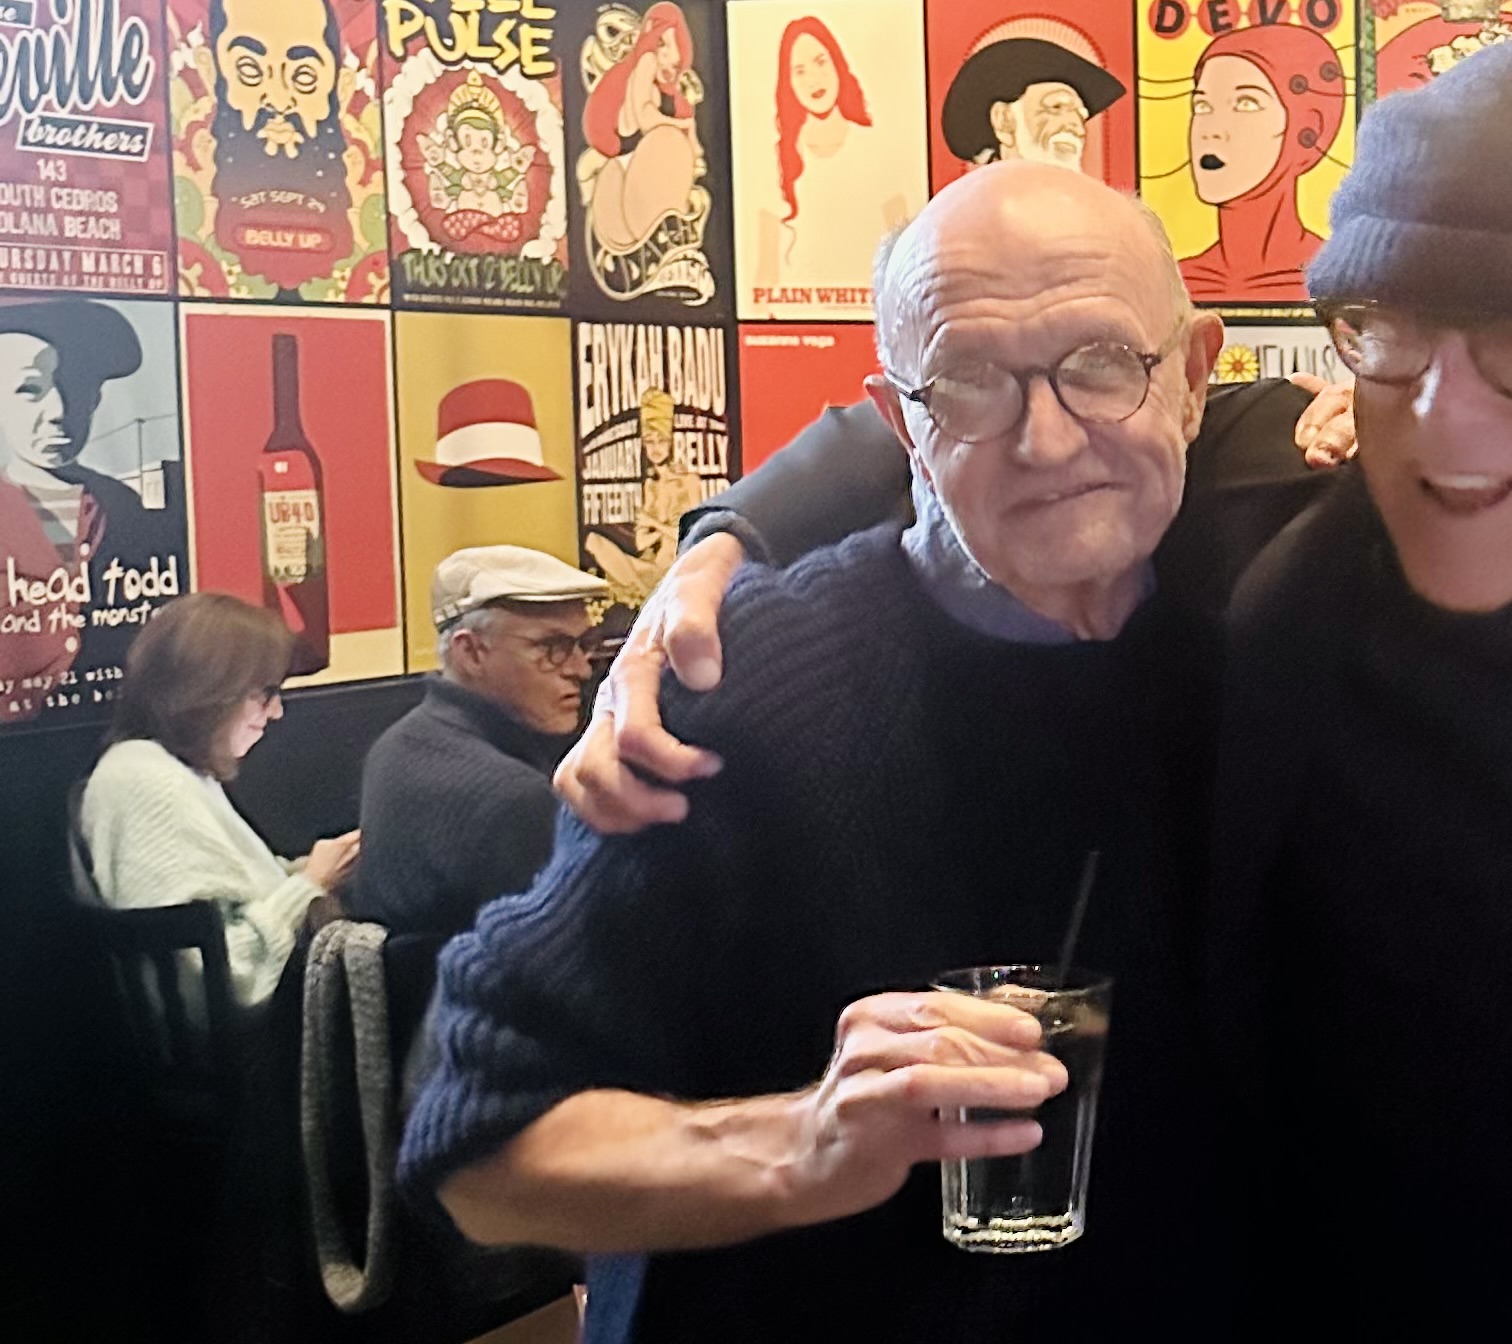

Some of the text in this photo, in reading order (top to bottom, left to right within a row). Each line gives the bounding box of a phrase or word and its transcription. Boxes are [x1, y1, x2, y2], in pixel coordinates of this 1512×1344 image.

[24, 118, 145, 154] brothers
[36, 159, 67, 183] 143
[51, 186, 119, 214] CEDROS
[63, 215, 121, 241] BEACH
[243, 229, 323, 248] BELLY UP
[81, 250, 140, 276] MARCH
[752, 287, 813, 305] PLAIN
[578, 322, 727, 440] ERYKAH BADU
[582, 437, 643, 480] JANUARY
[673, 430, 729, 475] BELLY
[269, 501, 316, 524] UB40
[7, 555, 179, 608] head todd
[1, 603, 86, 635] and the
[86, 665, 124, 683] with
[47, 692, 80, 709] the
